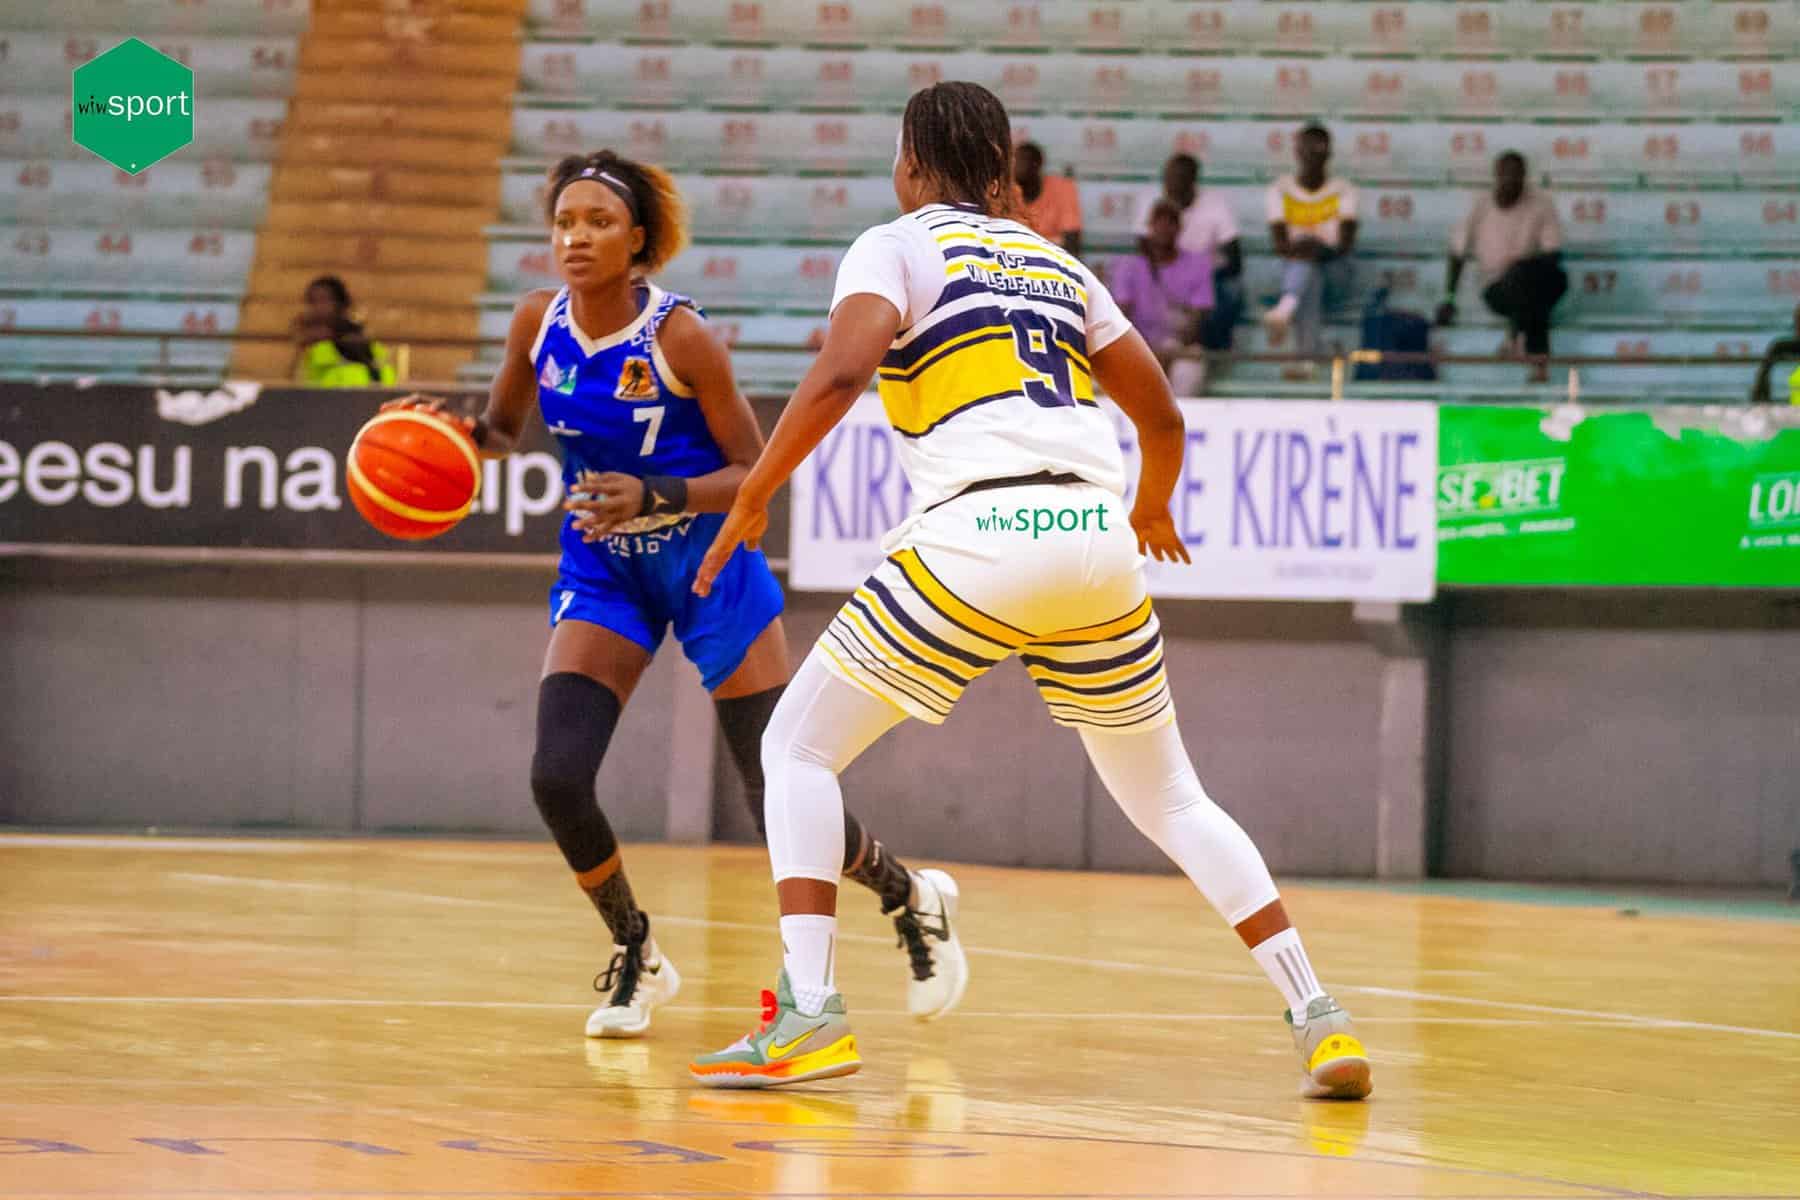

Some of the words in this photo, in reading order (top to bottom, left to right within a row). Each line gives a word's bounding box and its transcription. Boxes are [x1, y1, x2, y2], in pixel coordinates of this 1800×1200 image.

[1005, 309, 1076, 408] 9
[633, 405, 666, 457] 7
[224, 446, 342, 511] na
[812, 424, 912, 541] KIR
[1231, 415, 1419, 549] KIRÈNE
